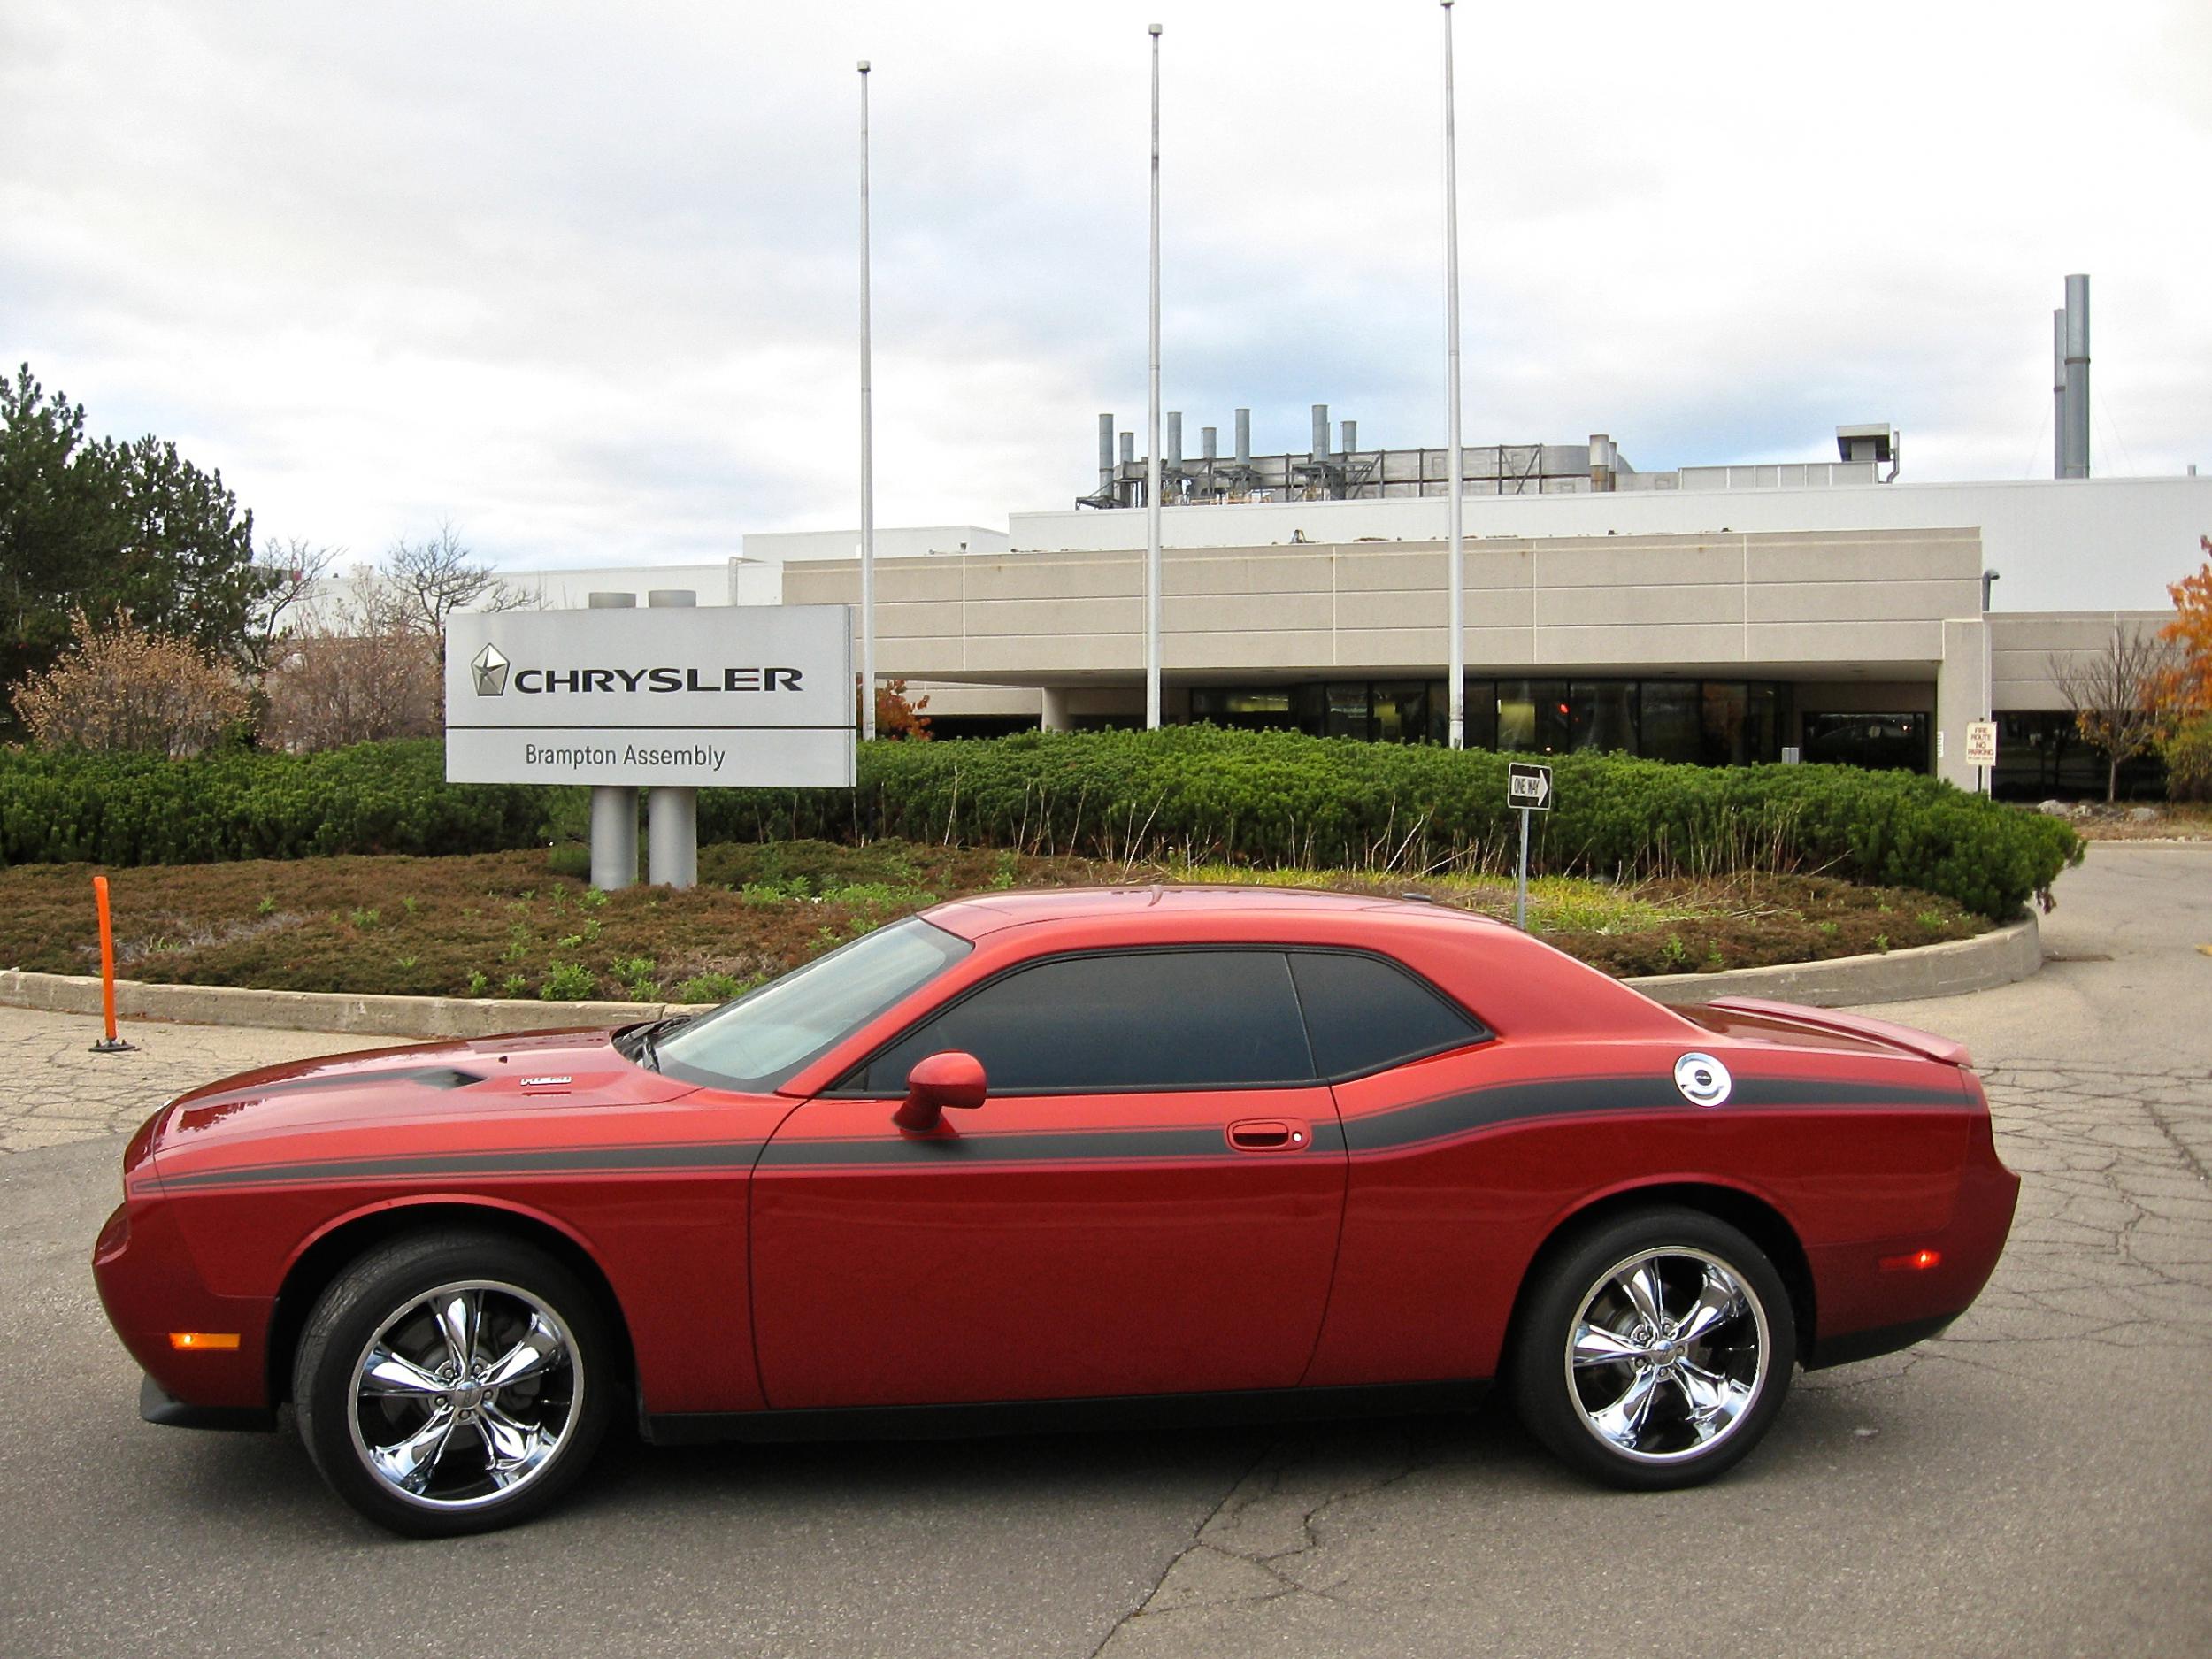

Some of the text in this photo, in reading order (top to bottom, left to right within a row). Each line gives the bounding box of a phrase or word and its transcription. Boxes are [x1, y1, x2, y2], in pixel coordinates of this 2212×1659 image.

[514, 668, 803, 694] CHRYSLER
[526, 744, 726, 771] Brampton Assembly
